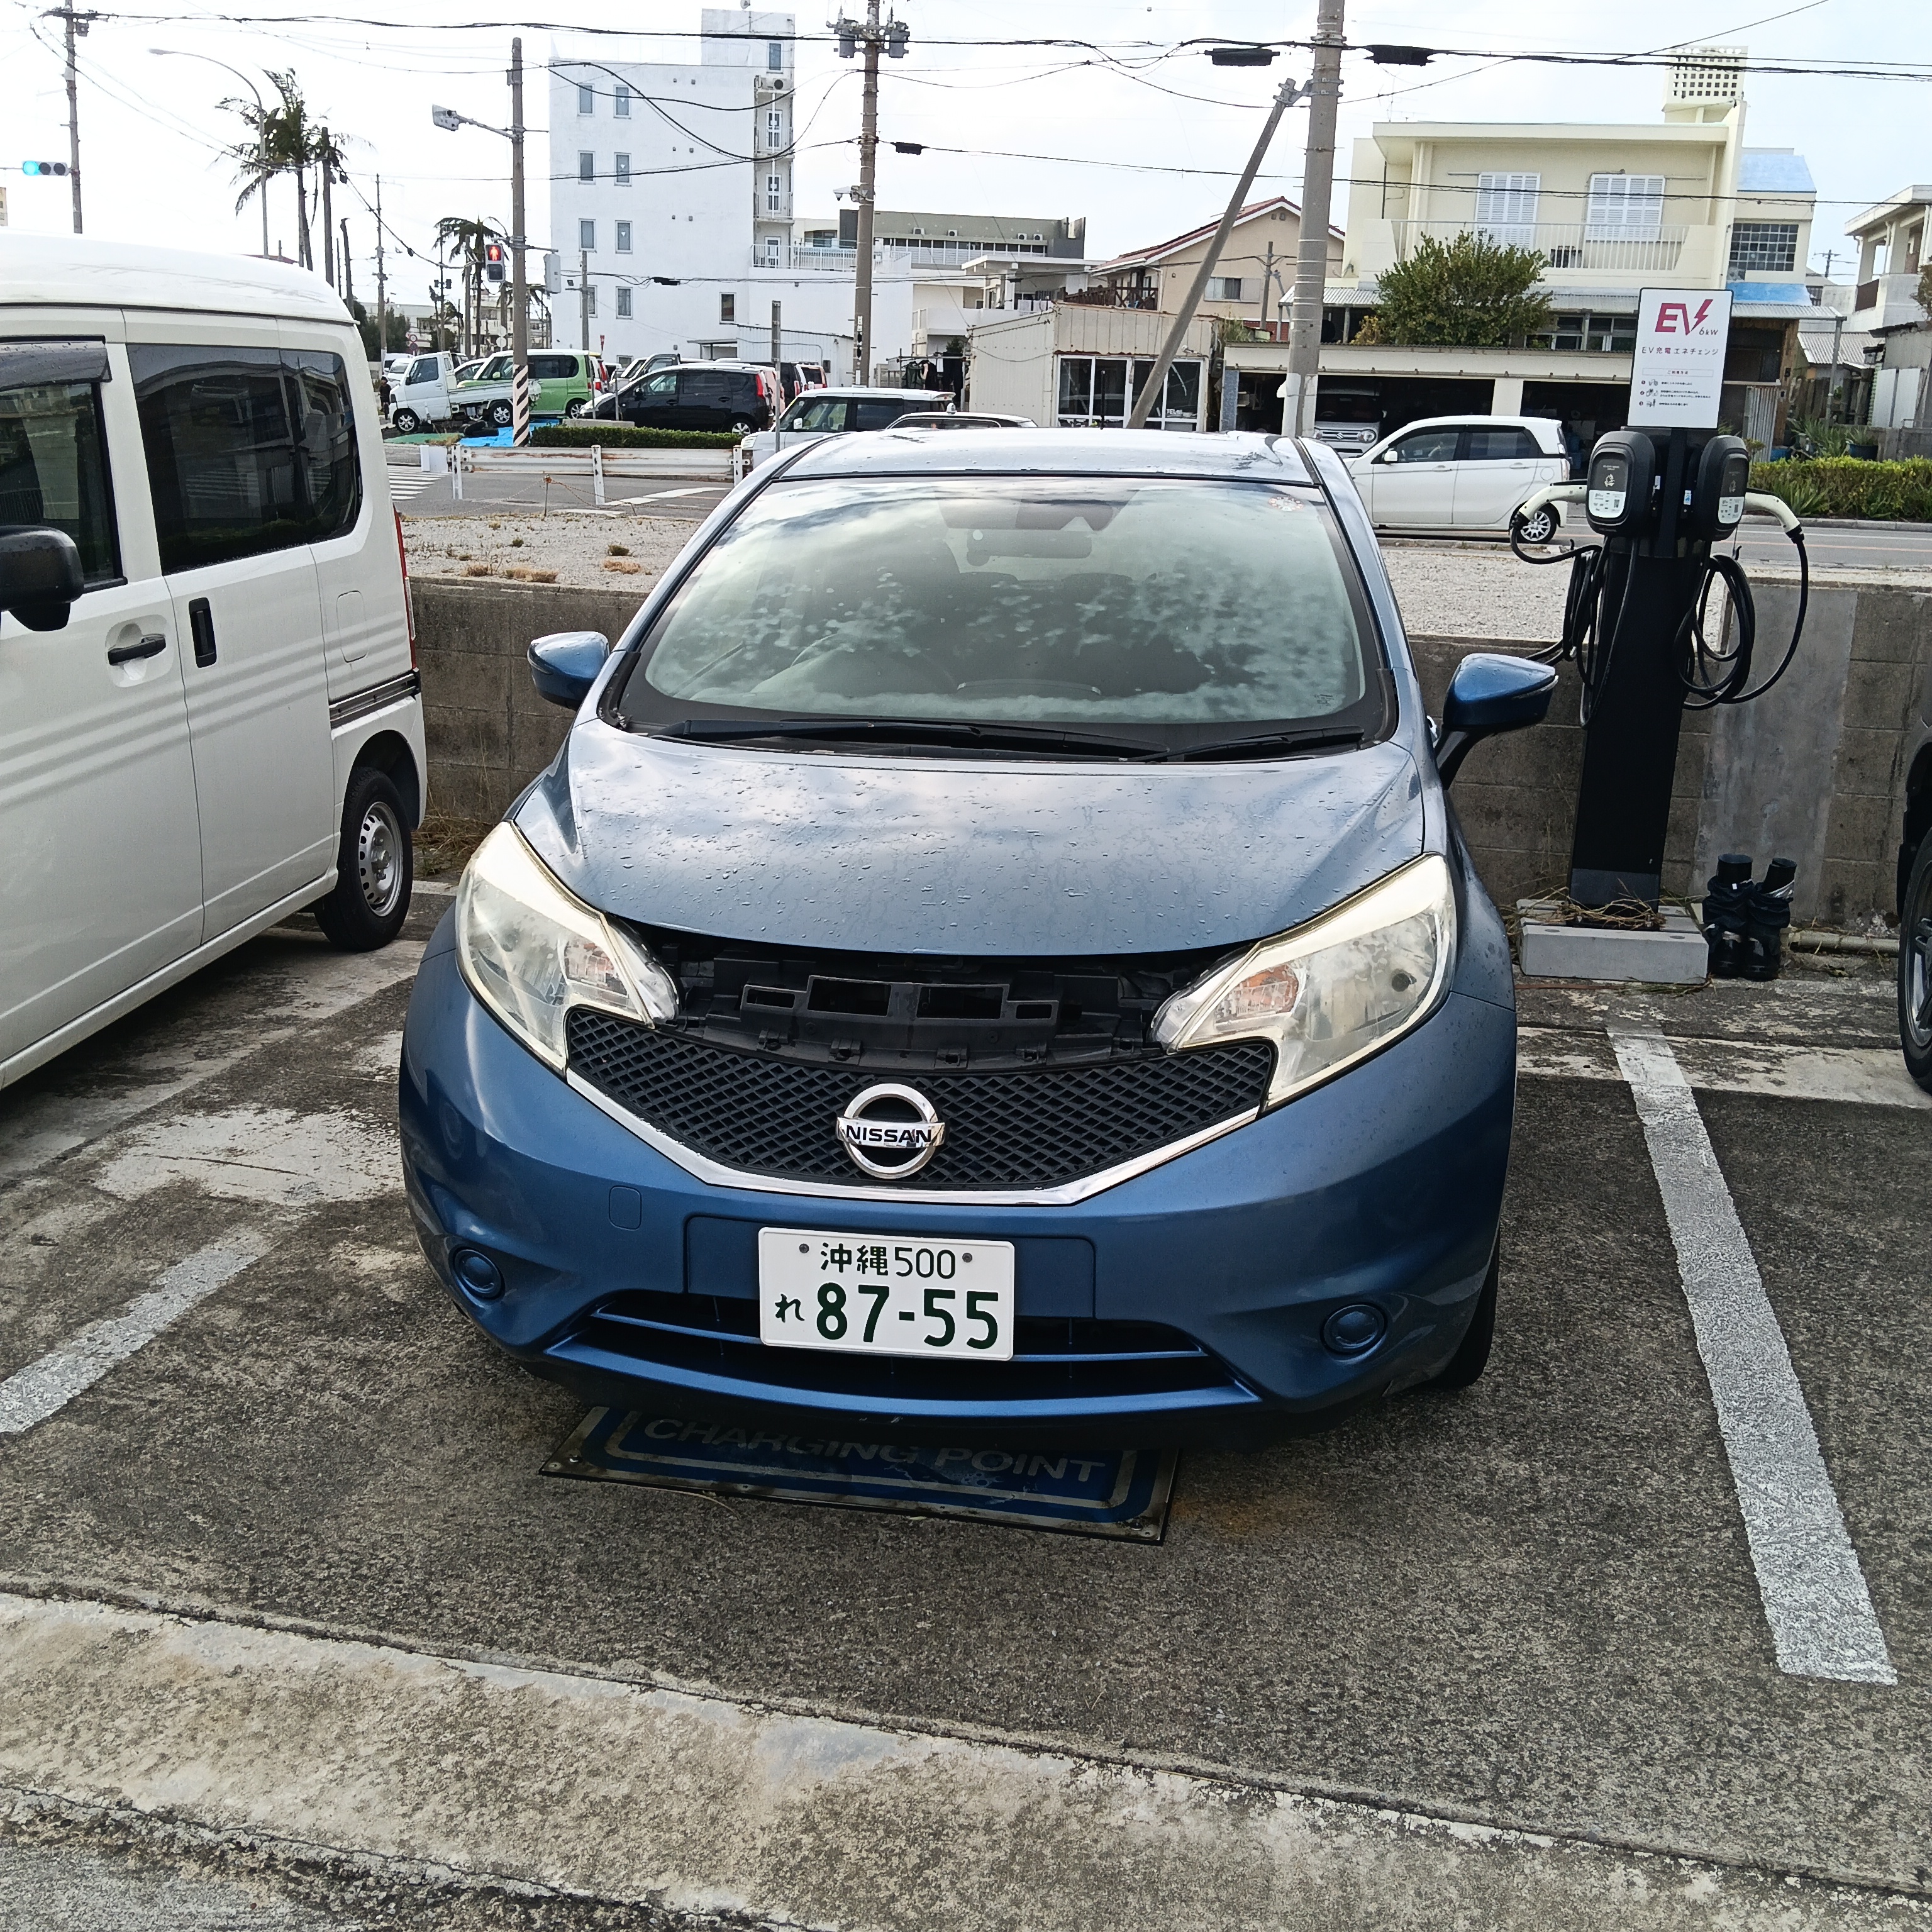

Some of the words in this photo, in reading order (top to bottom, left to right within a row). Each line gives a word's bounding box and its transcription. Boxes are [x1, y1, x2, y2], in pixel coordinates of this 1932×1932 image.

[1655, 299, 1713, 335] EV
[1699, 327, 1718, 335] 6kW
[846, 1125, 931, 1143] NISSAN
[774, 1293, 805, 1323] れ
[816, 1282, 999, 1350] 87-55
[644, 1419, 918, 1464] CHARGING
[935, 1448, 1106, 1482] POINT
